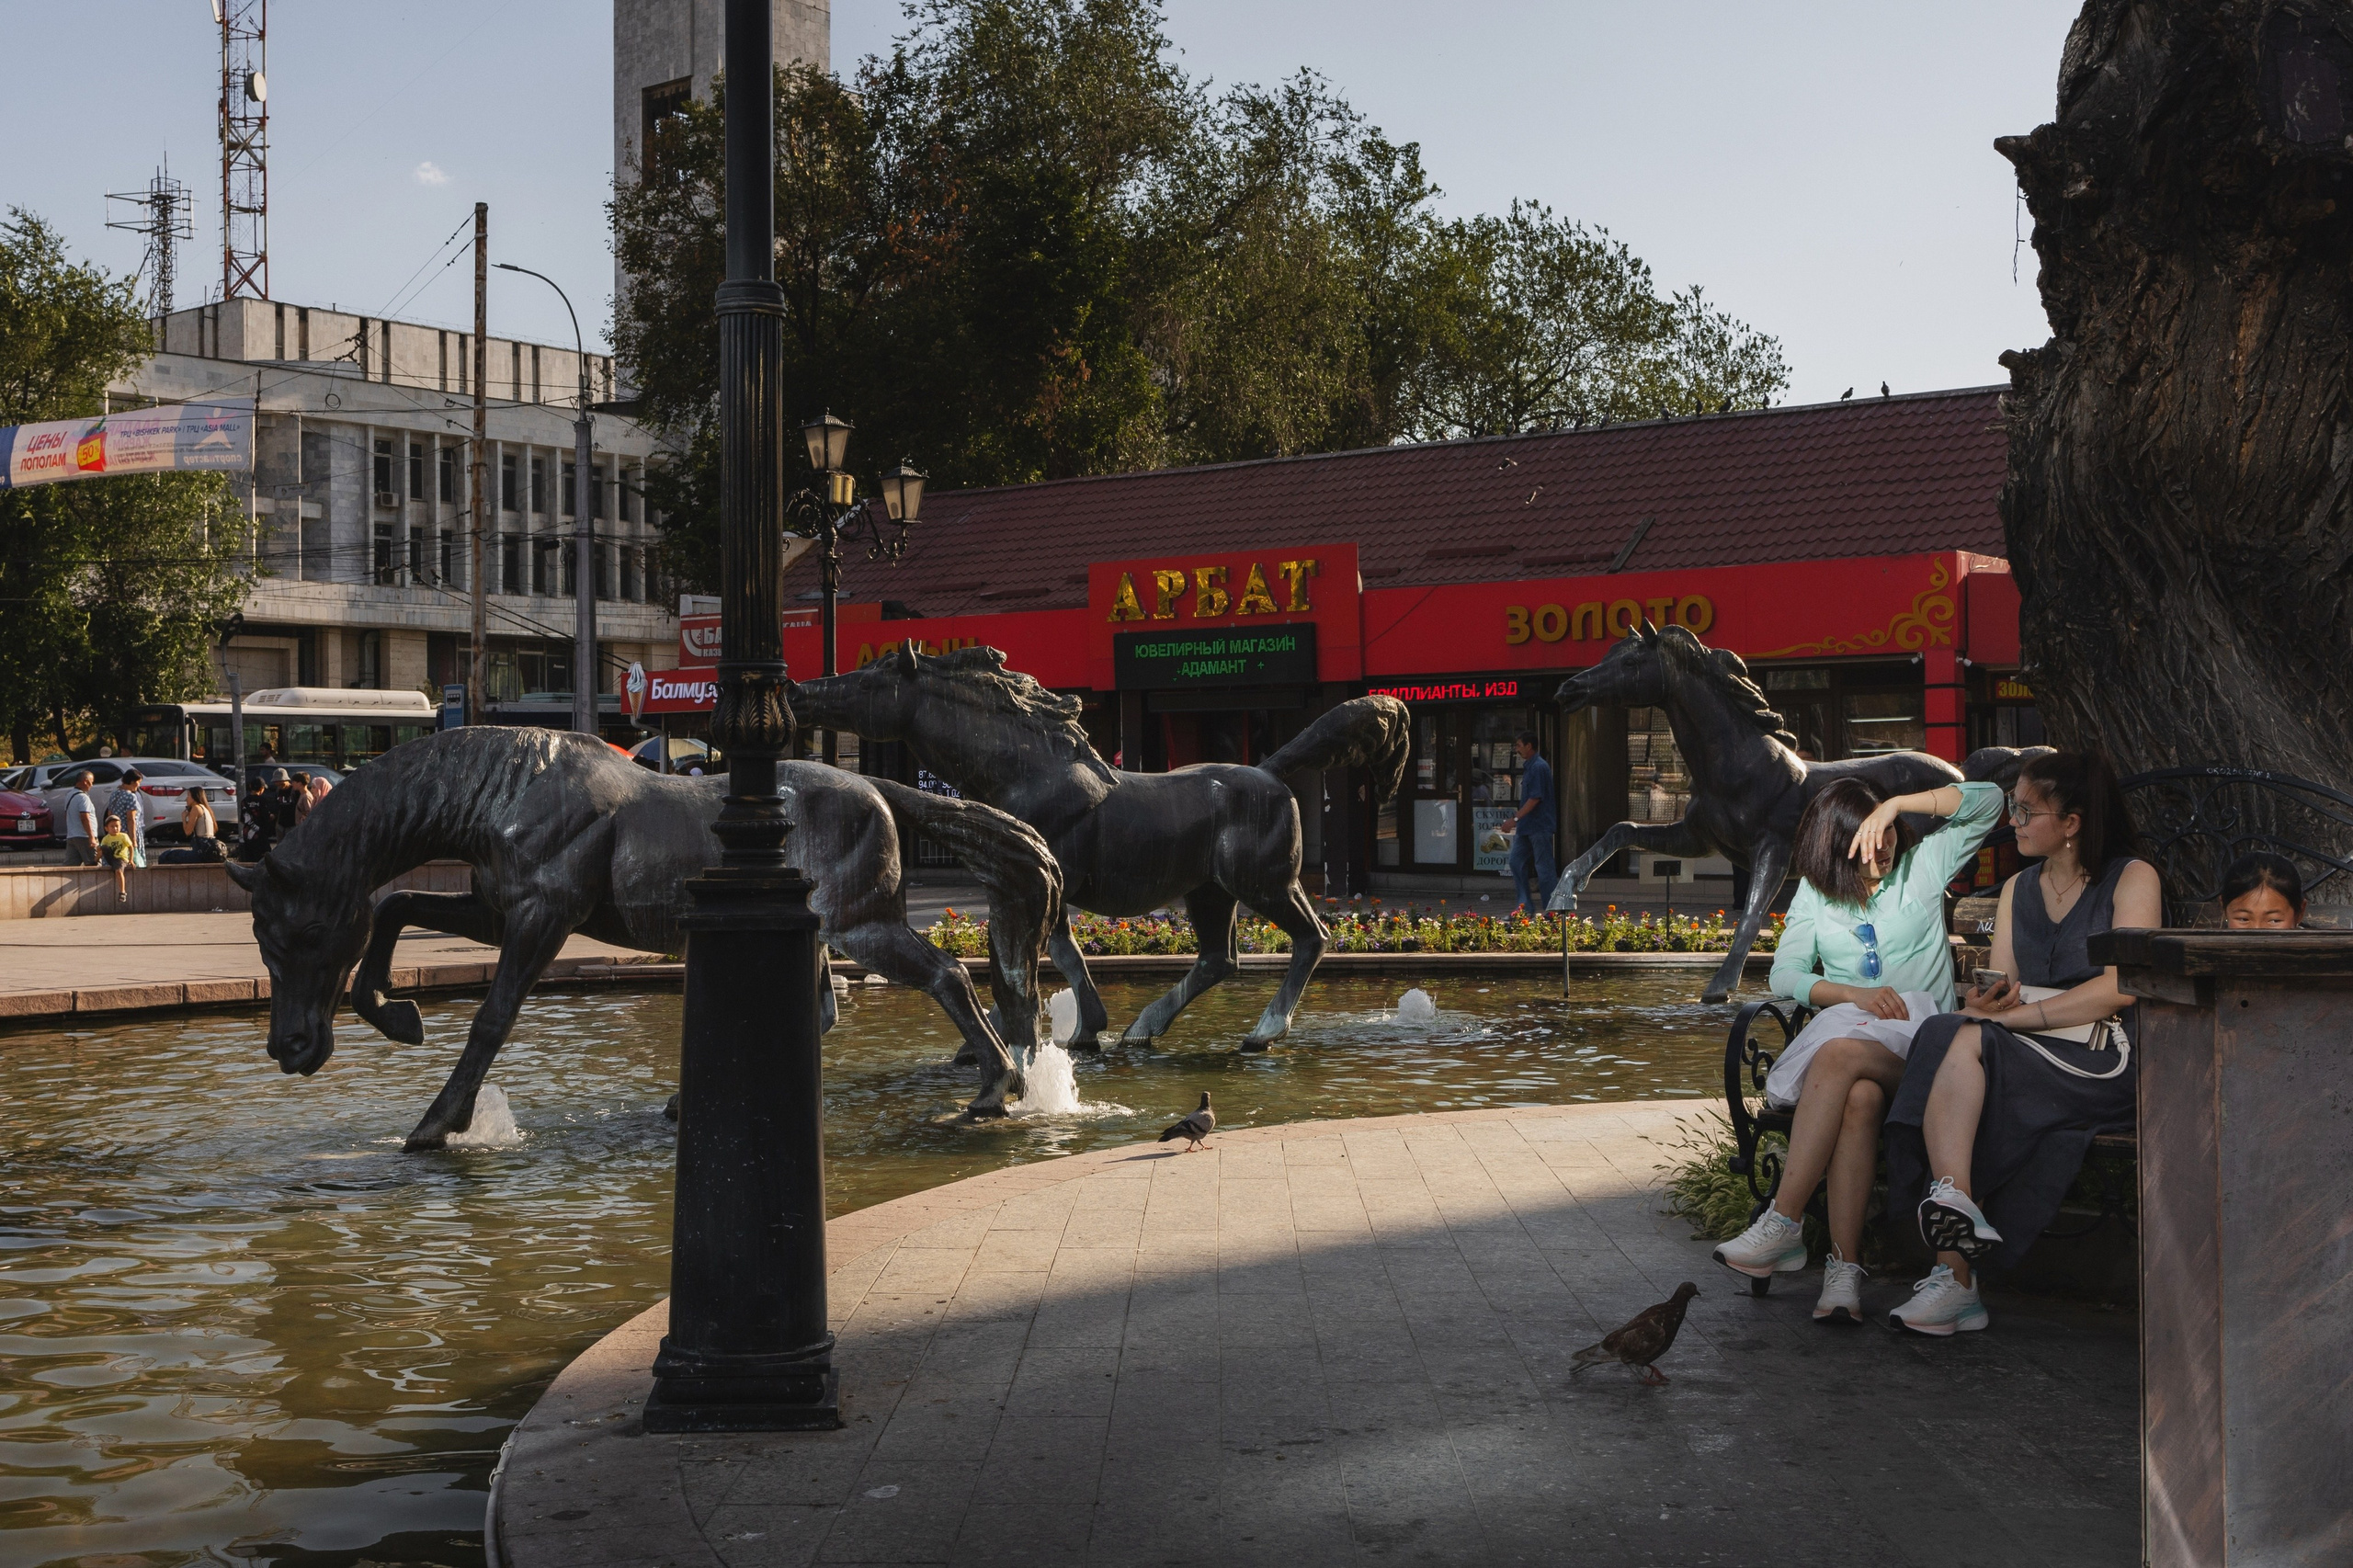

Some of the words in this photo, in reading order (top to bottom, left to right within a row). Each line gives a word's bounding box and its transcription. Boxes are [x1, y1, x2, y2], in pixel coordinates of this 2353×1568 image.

[120, 430, 131, 438] ТРЦ
[187, 425, 199, 434] ТРЦ
[27, 431, 68, 454] ЦЕНЫ
[20, 453, 67, 472] ПОПОЛАМ
[1106, 559, 1320, 622] АРБАТ
[1506, 594, 1715, 645] ЗОЛОТО
[703, 626, 722, 644] БА
[1134, 638, 1226, 658] ЮВЕЛИРНЫЙ
[1229, 636, 1296, 654] МАГАЗИН
[1181, 659, 1247, 677] АДАМАНТ
[651, 678, 719, 704] Балмуз
[1998, 681, 2033, 697] ЗОЛ
